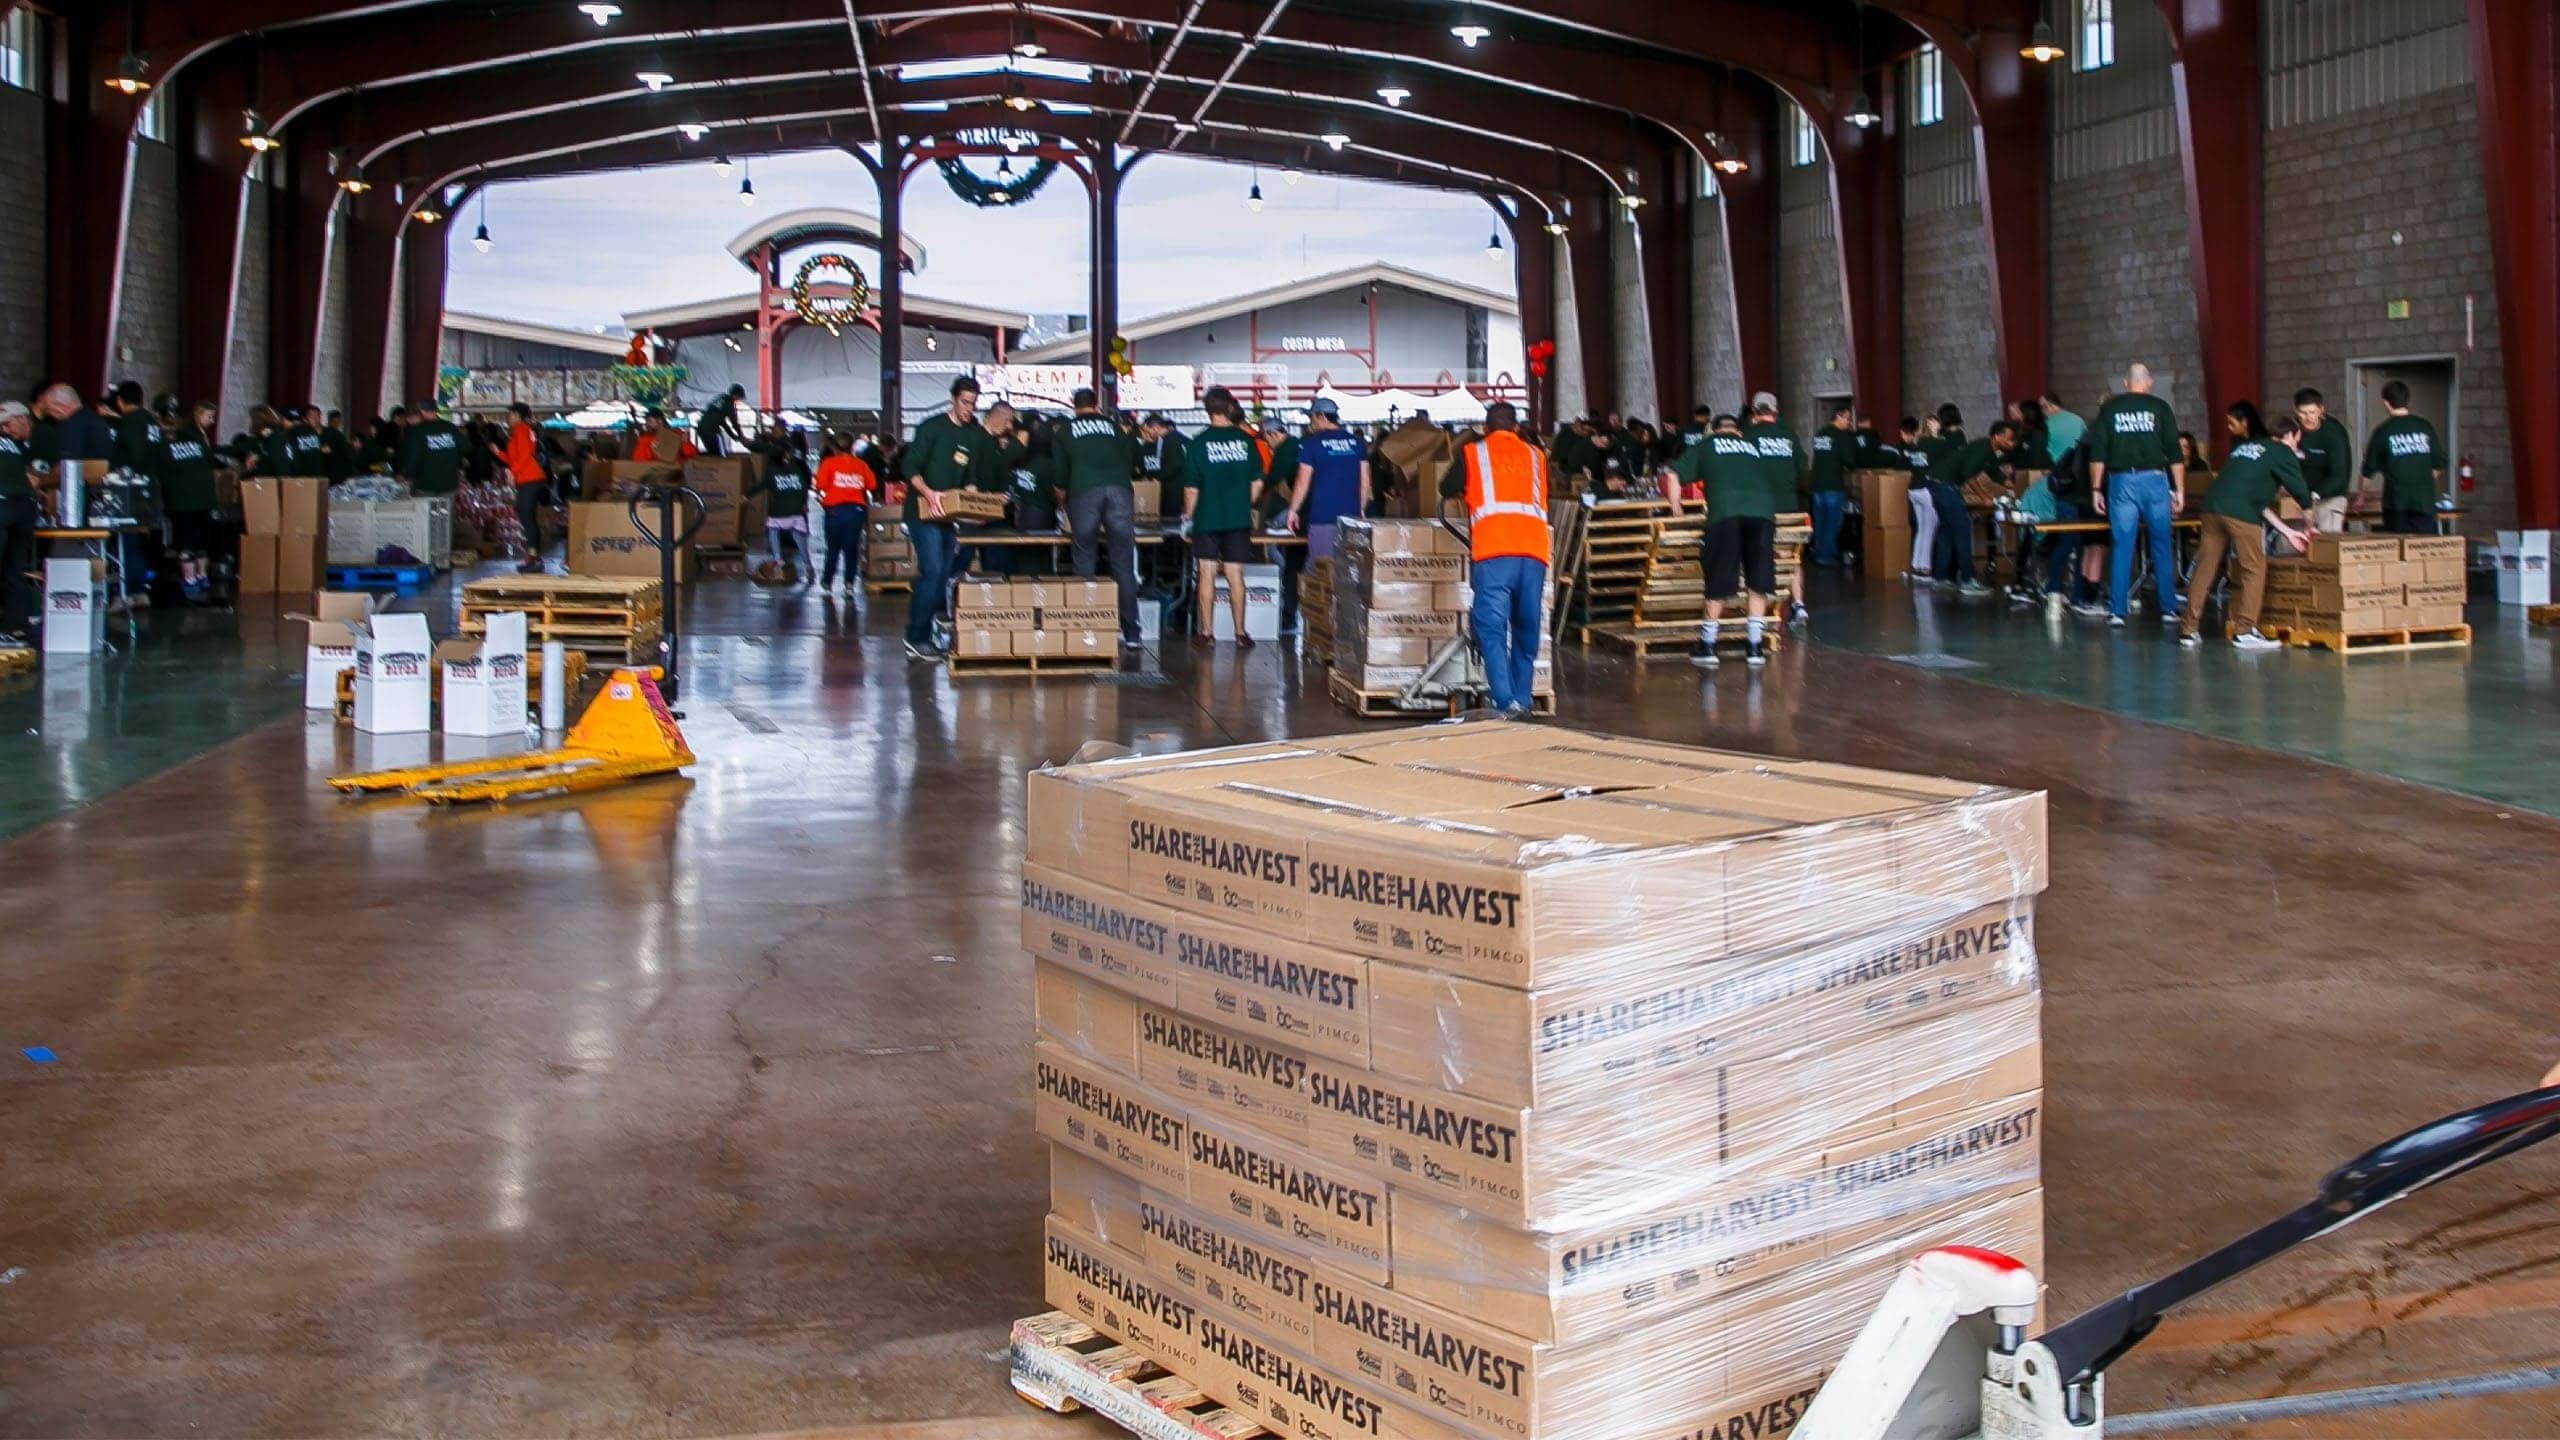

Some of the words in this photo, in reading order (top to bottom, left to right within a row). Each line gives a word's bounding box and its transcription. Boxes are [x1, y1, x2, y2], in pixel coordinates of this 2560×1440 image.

[1282, 336, 1315, 351] COSTA
[1316, 336, 1346, 351] MESA
[1130, 819, 1192, 863] SHARE
[1201, 835, 1300, 887] HARVEST
[1023, 879, 1075, 922] SHARE
[1083, 900, 1168, 955] HARVEST
[1310, 862, 1386, 905] SHARE
[1387, 873, 1397, 906] THE
[1397, 875, 1521, 928] HARVEST
[1178, 932, 1243, 979] SHARE
[1252, 952, 1359, 1010] HARVEST
[1473, 946, 1524, 964] PIMCO
[1143, 1012, 1203, 1059] SHARE
[1212, 1034, 1307, 1093] HARVEST
[1318, 1024, 1360, 1045] PIMCO
[1038, 1062, 1091, 1112] SHARE
[1098, 1087, 1184, 1152] HARVEST
[1311, 1072, 1386, 1125] SHARE
[1386, 1092, 1396, 1126] THE
[1396, 1096, 1517, 1163] HARVEST
[1192, 1130, 1260, 1185] SHARE
[1269, 1158, 1378, 1228] HARVEST
[1470, 1175, 1521, 1200] PIMCO
[1141, 1202, 1203, 1255] SHARE
[1211, 1232, 1309, 1303] HARVEST
[1335, 1237, 1381, 1261] PIMCO
[1047, 1236, 1101, 1289] SHARE
[1108, 1266, 1196, 1336] HARVEST
[1161, 1343, 1197, 1367] PIMCO
[1270, 1310, 1310, 1335] PIMCO
[1313, 1282, 1391, 1342] SHARE
[1391, 1312, 1402, 1345] THE
[1401, 1316, 1525, 1397] HARVEST
[1200, 1319, 1266, 1380] SHARE
[1267, 1350, 1276, 1382] THE
[1276, 1355, 1382, 1436] HARVEST
[1476, 1405, 1527, 1434] PIMCO
